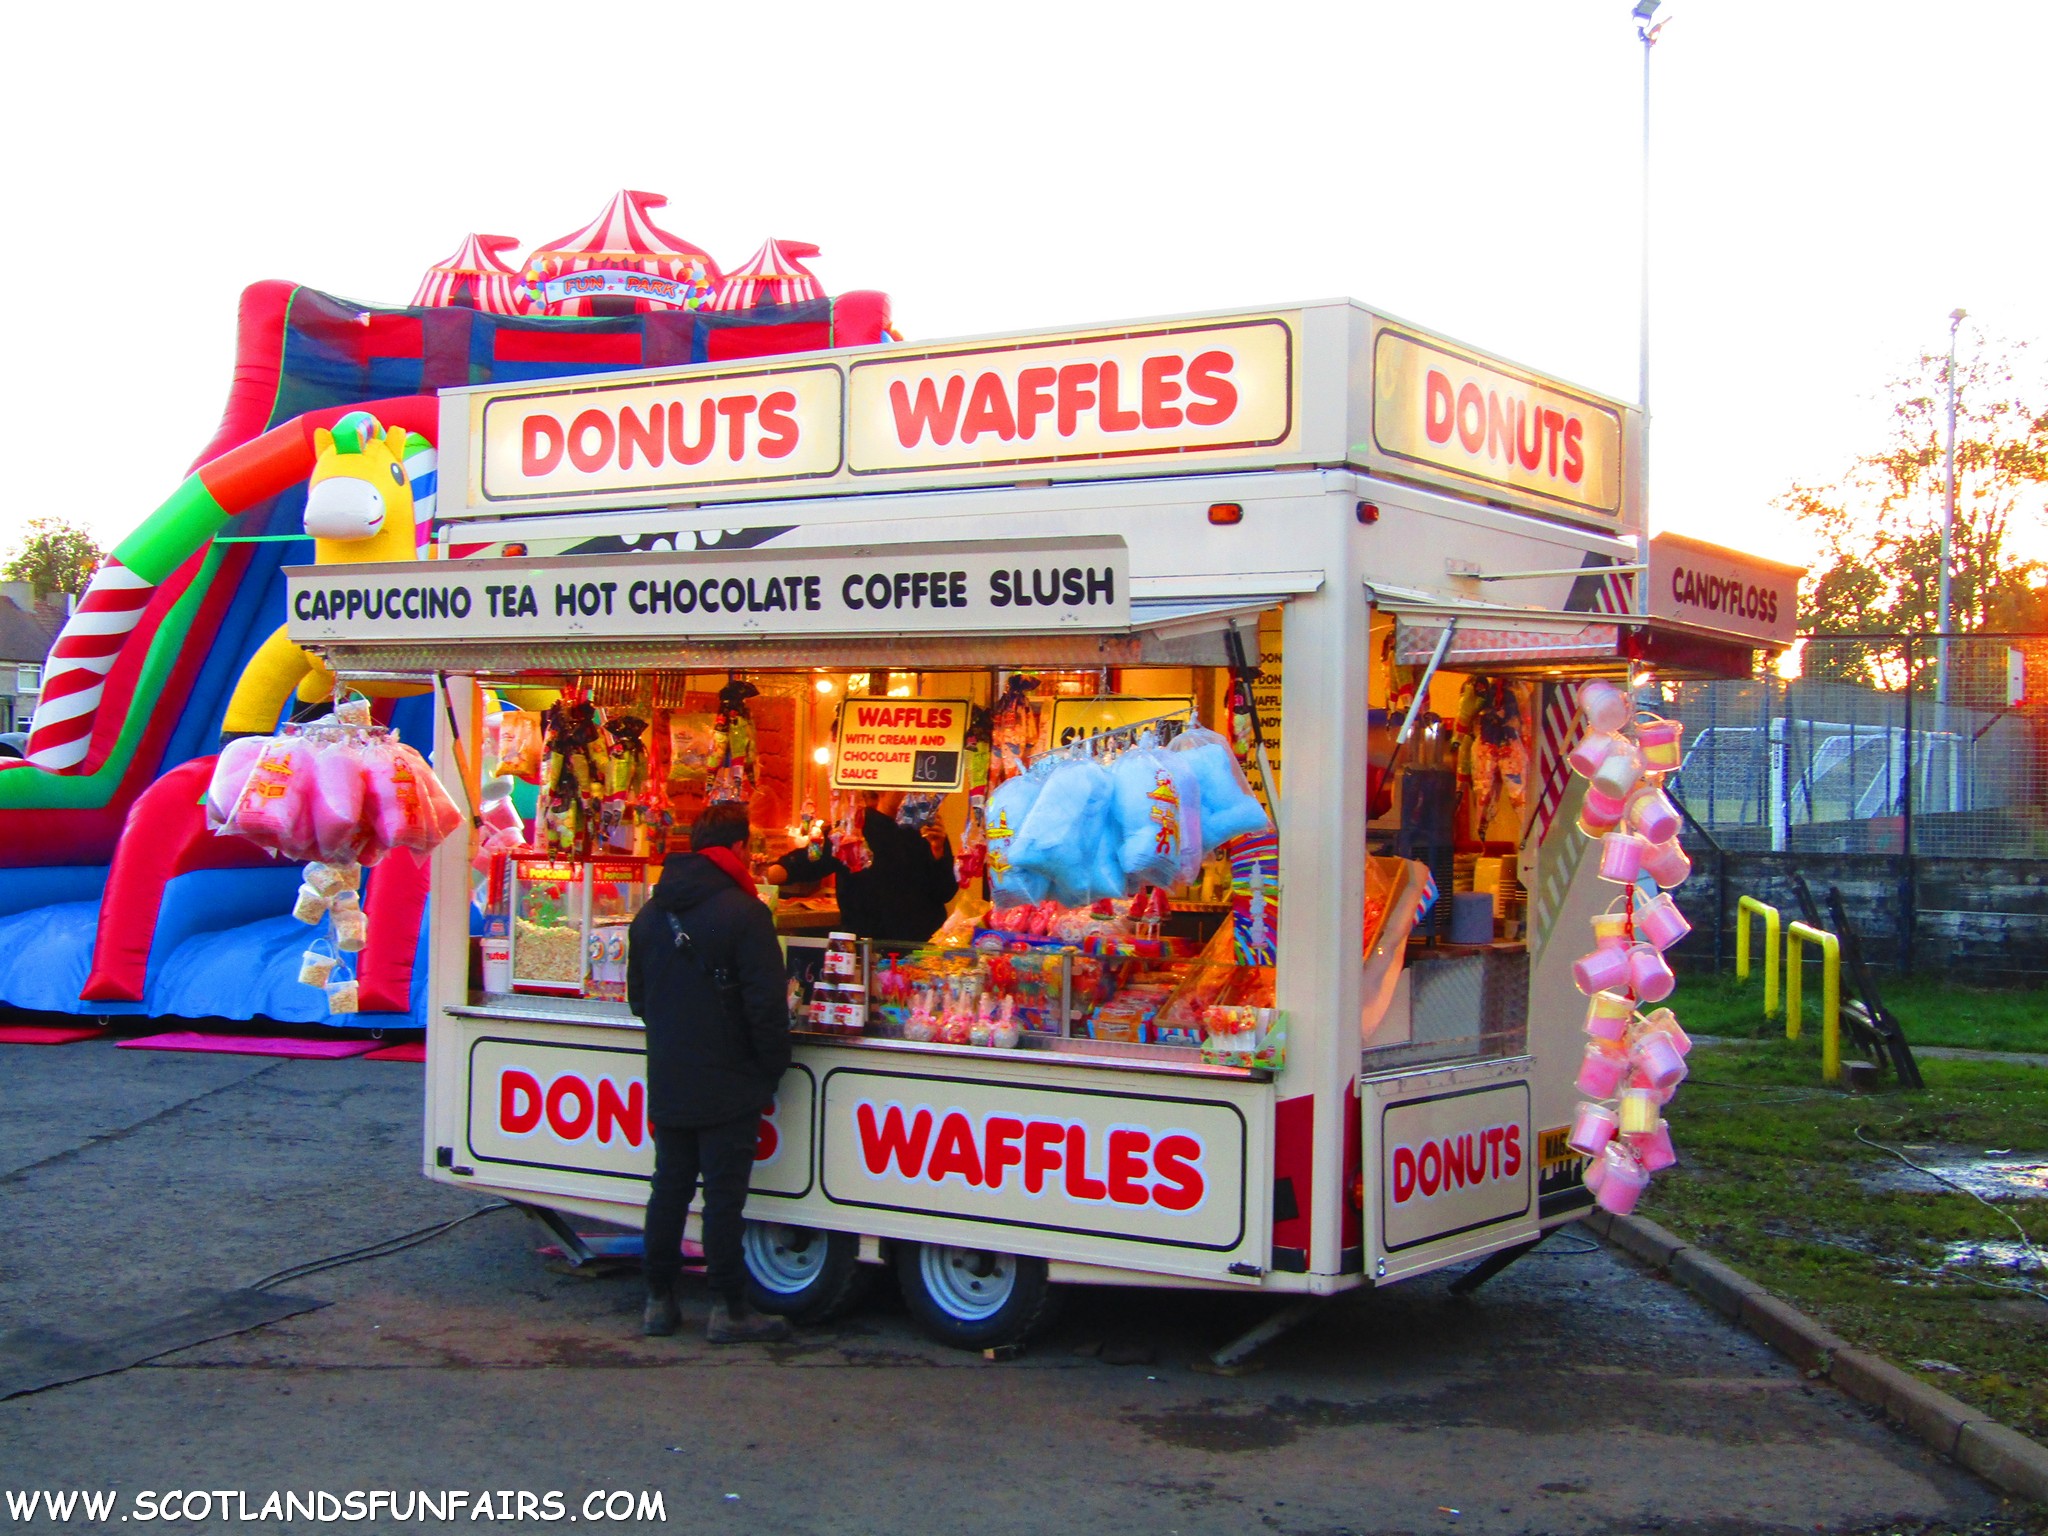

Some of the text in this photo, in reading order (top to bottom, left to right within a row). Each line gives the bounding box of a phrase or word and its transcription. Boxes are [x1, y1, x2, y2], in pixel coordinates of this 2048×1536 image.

[564, 275, 679, 299] FUN PARK
[888, 349, 1242, 449] WAFFLES
[521, 390, 799, 478] DONUTS
[1425, 369, 1584, 485] DONUTS
[294, 567, 1115, 621] CAPPUCCINO TEA HOT CHOCOLATE COFFEE SLUSH
[1672, 566, 1778, 624] CANDYFLOSS
[845, 734, 946, 747] WITH CREAM AND
[857, 707, 952, 728] WAFFLES
[841, 768, 878, 779] SAUCE
[843, 750, 911, 763] CHOCOLATE
[529, 868, 571, 880] POPCORN
[856, 1101, 1205, 1212] WAFFLES
[1393, 1124, 1521, 1203] DONUTS
